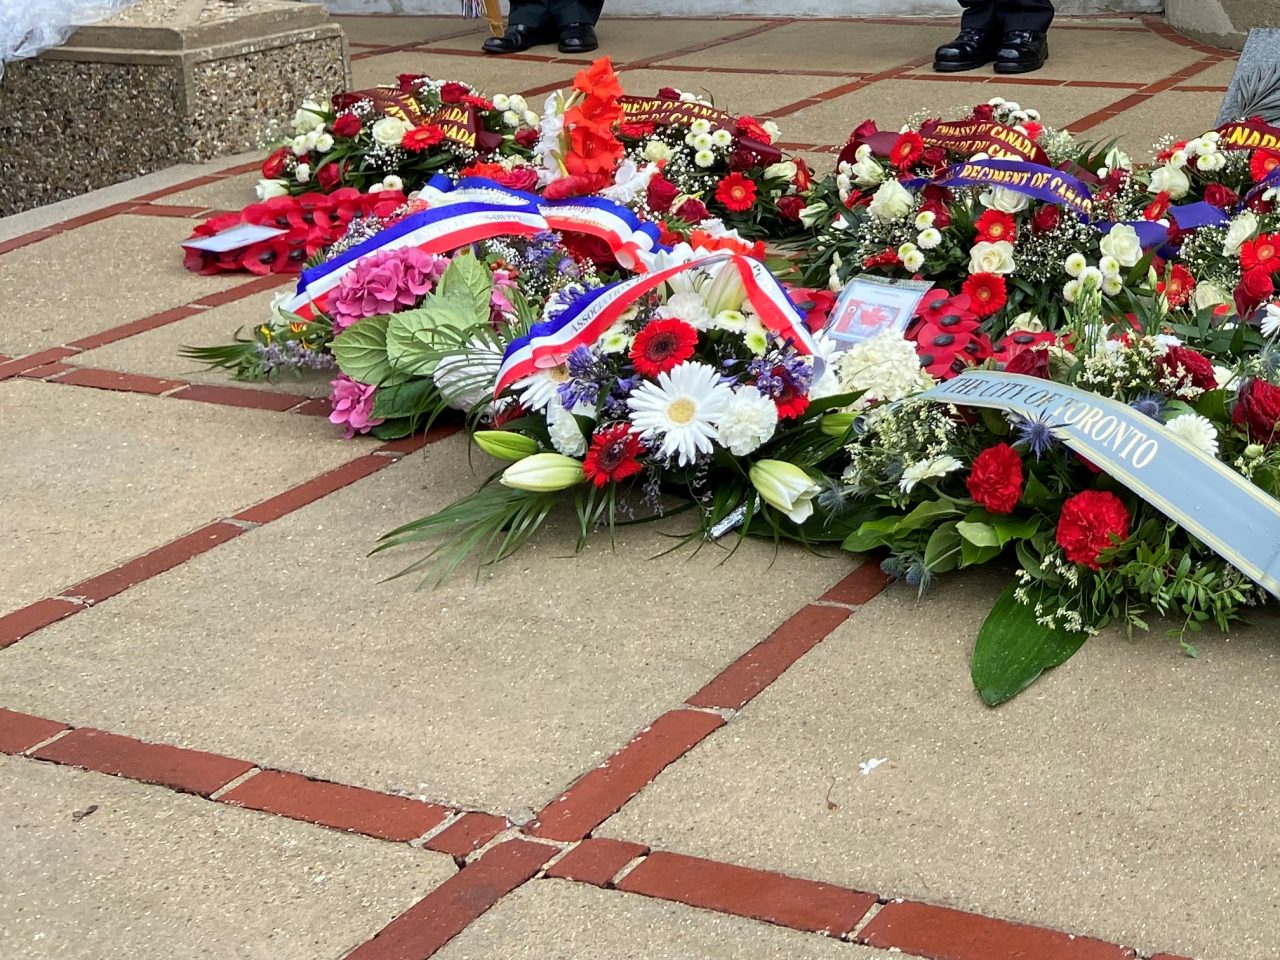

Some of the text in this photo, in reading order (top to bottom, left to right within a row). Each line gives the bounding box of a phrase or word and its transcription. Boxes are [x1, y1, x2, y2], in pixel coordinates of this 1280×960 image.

[933, 125, 977, 138] EMBASSY
[990, 126, 1037, 161] CANADA
[959, 164, 1031, 186] REGIMENT
[1029, 172, 1053, 189] OF
[942, 377, 1160, 470] THE CITY OF TORONTO
